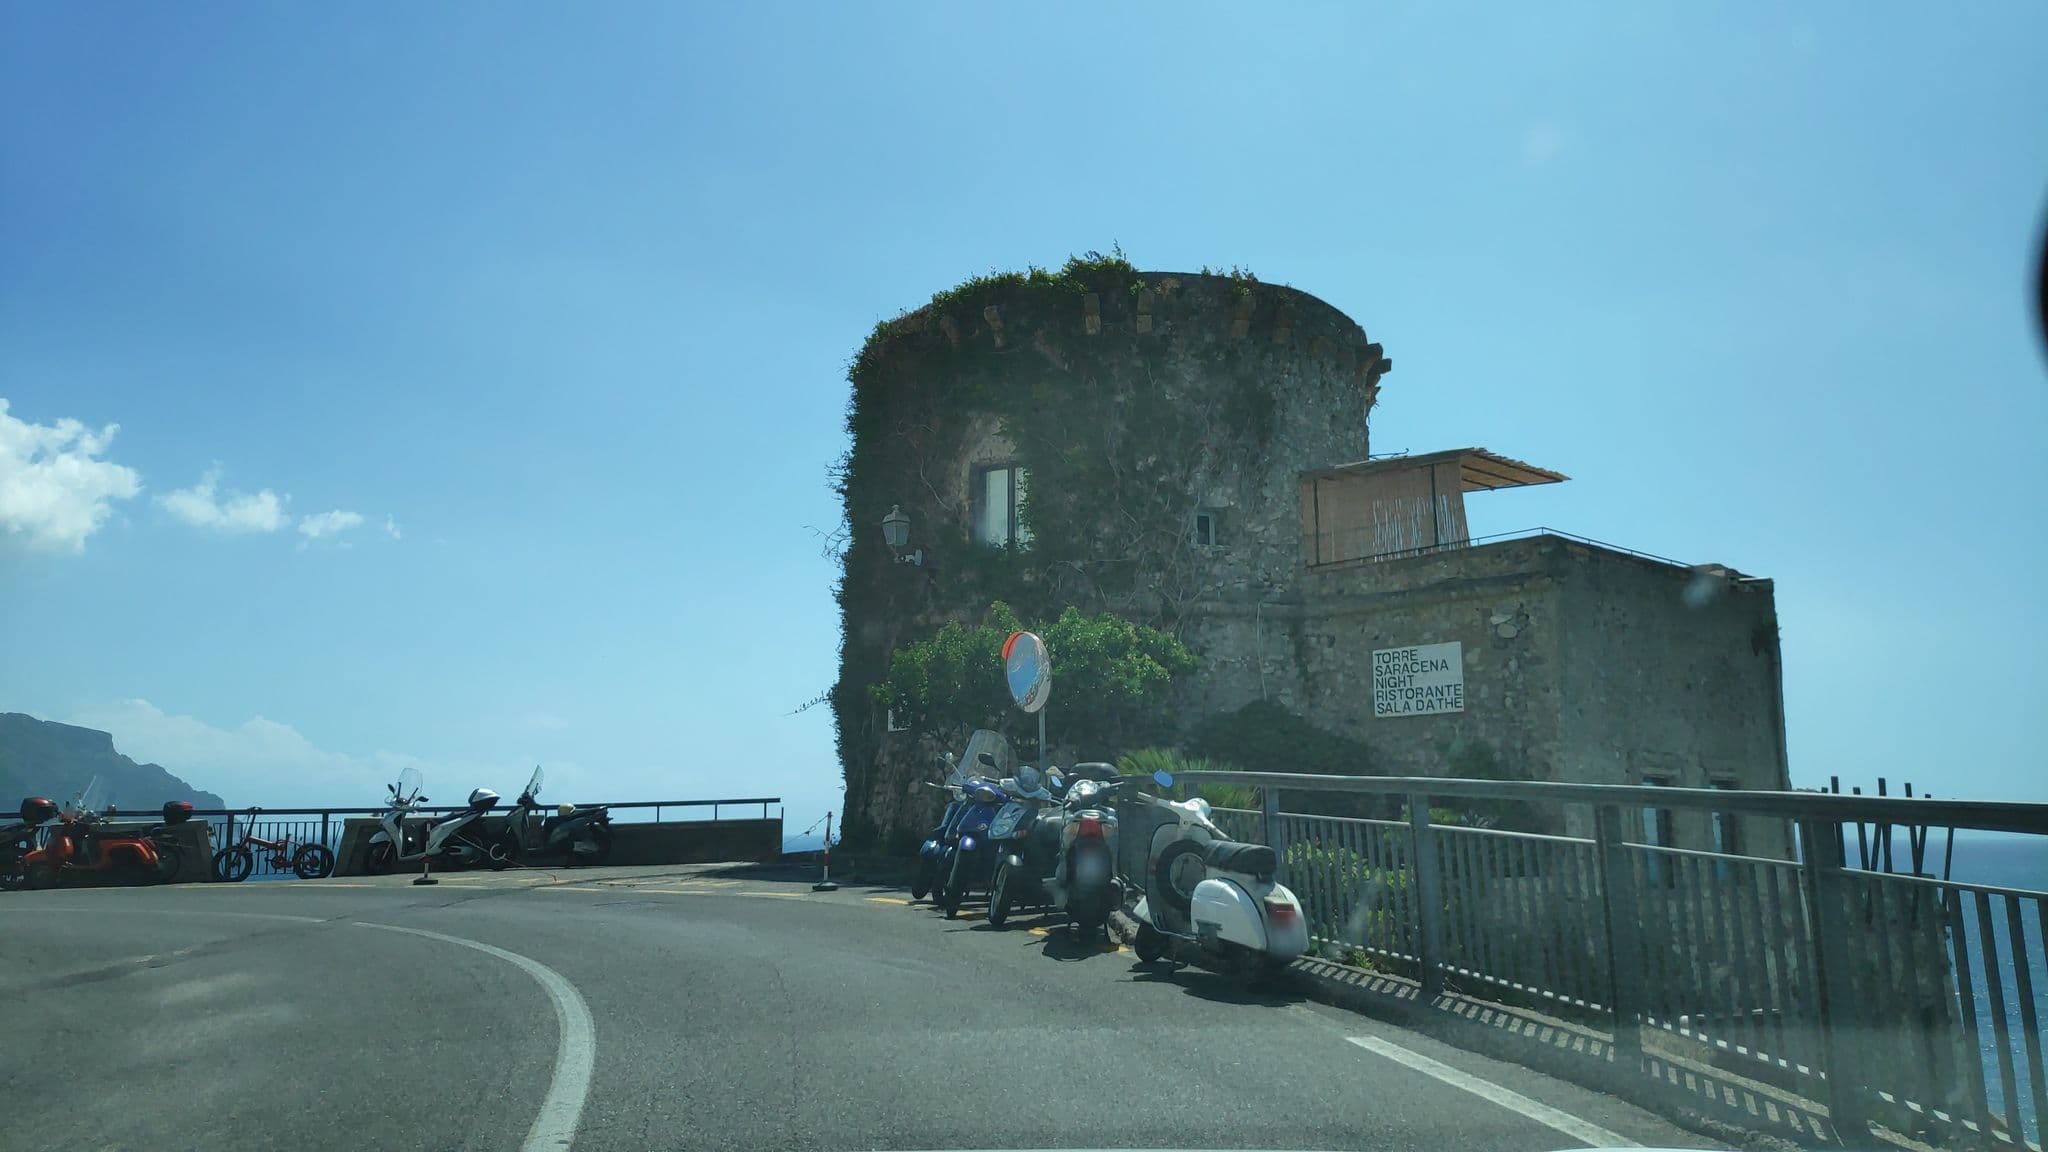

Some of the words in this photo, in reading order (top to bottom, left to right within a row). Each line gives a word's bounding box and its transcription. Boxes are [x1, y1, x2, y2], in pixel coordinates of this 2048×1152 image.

[1375, 649, 1418, 664] TORRE
[1375, 659, 1449, 677] SARACENA
[1376, 674, 1415, 689] NIGHT
[1376, 683, 1463, 702] RISTORANTE
[1377, 701, 1411, 714] SALA
